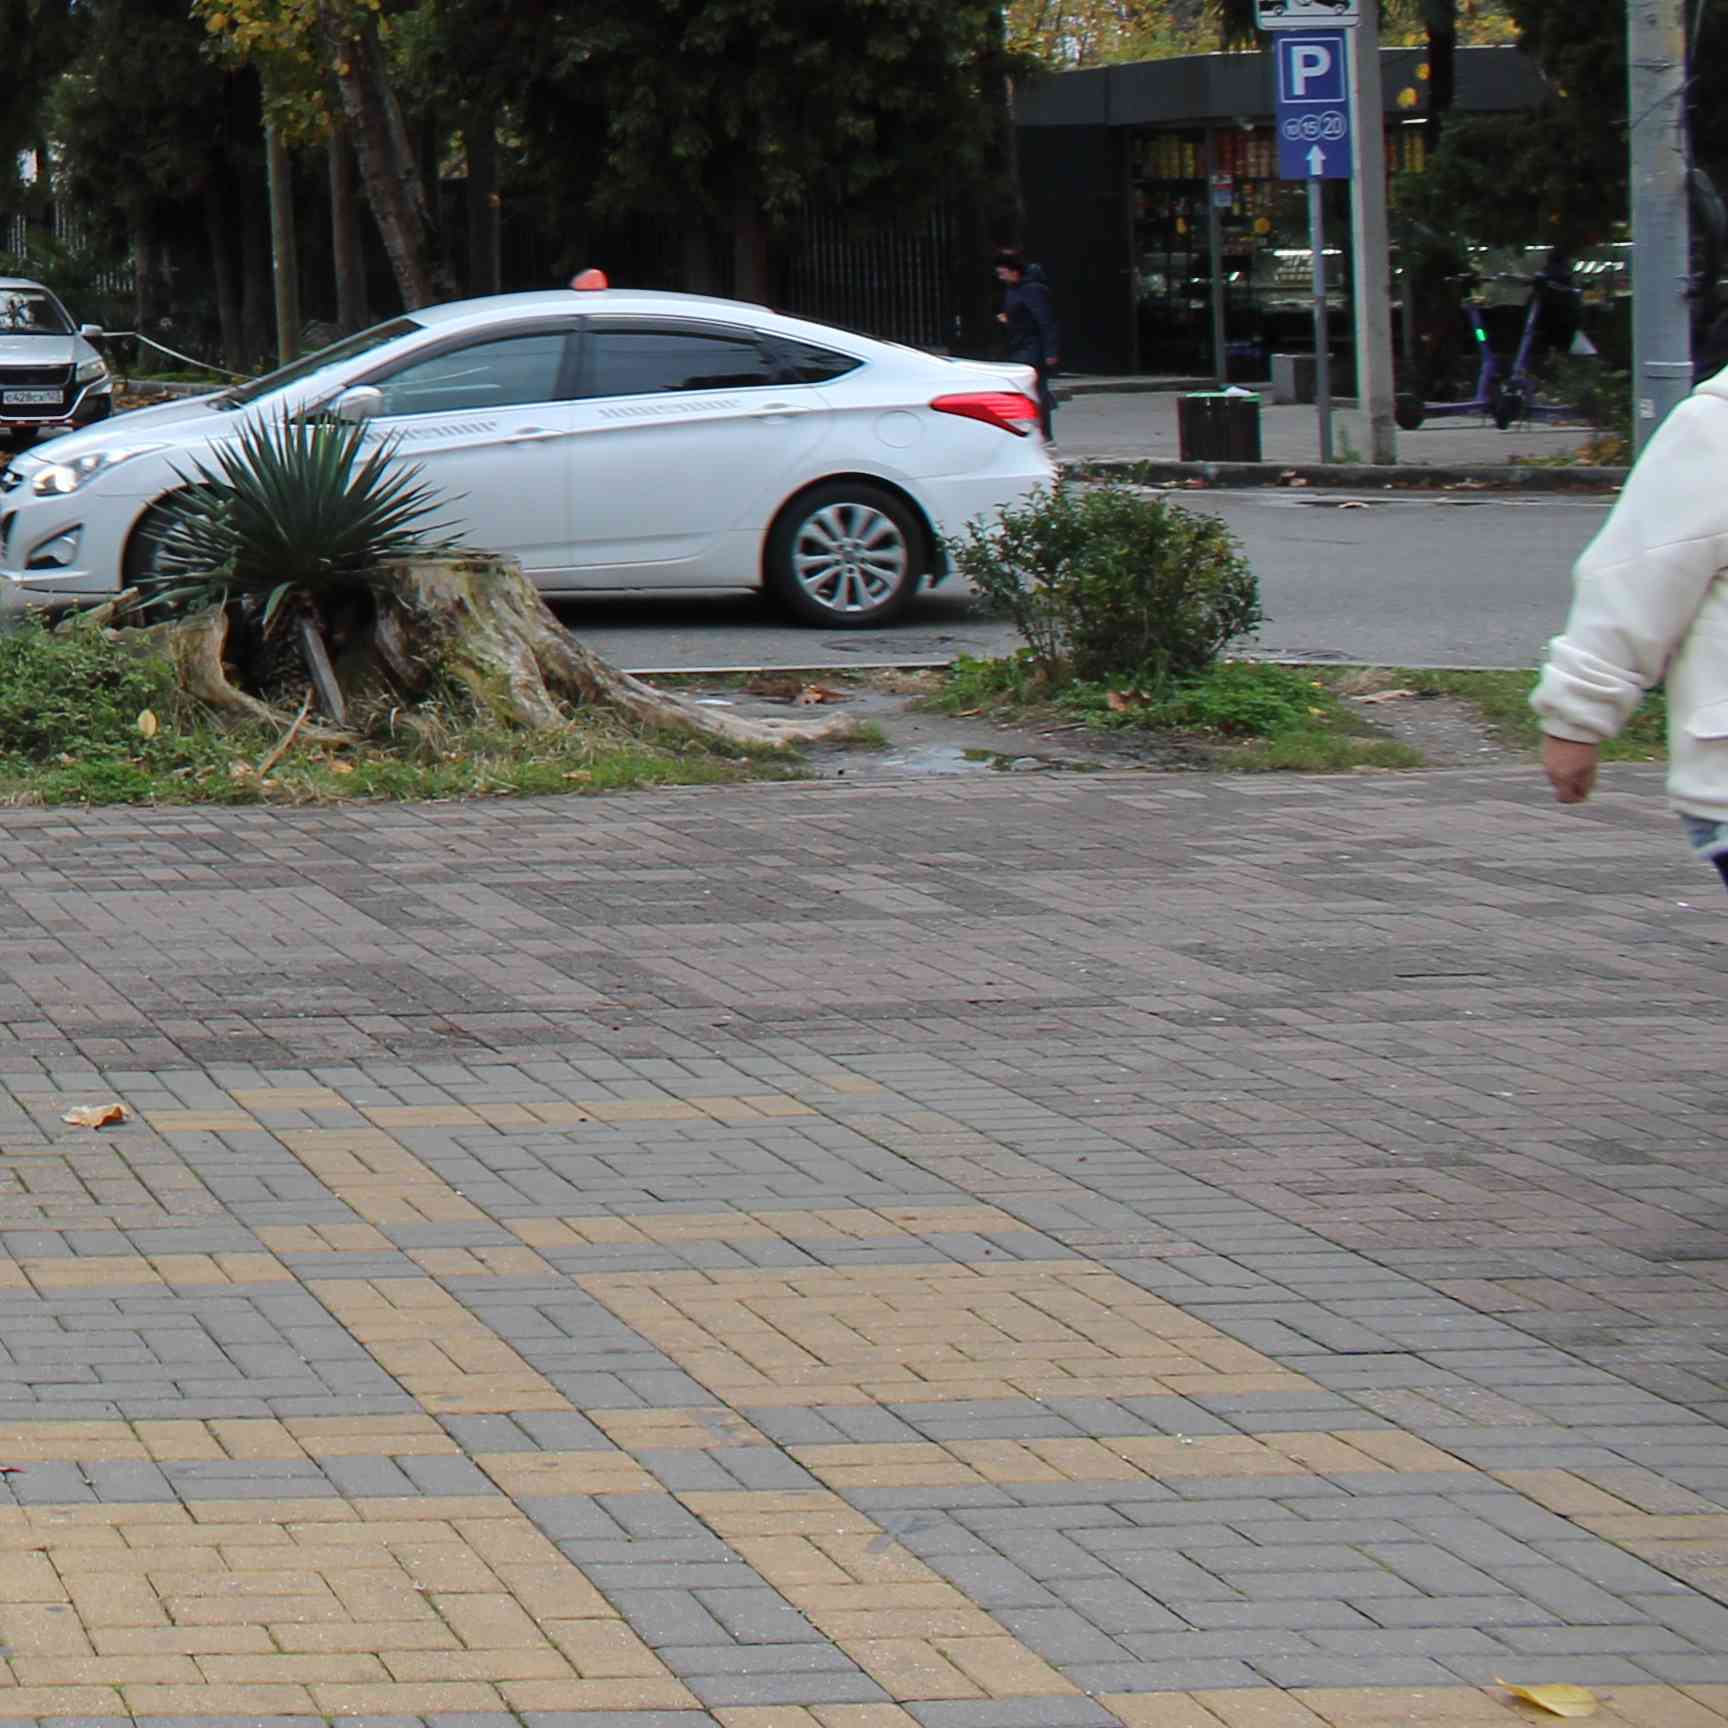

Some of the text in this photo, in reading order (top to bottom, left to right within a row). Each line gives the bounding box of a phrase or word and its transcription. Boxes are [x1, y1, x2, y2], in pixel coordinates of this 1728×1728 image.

[1291, 45, 1331, 96] P
[1302, 120, 1318, 134] 15
[1323, 117, 1342, 134] 20
